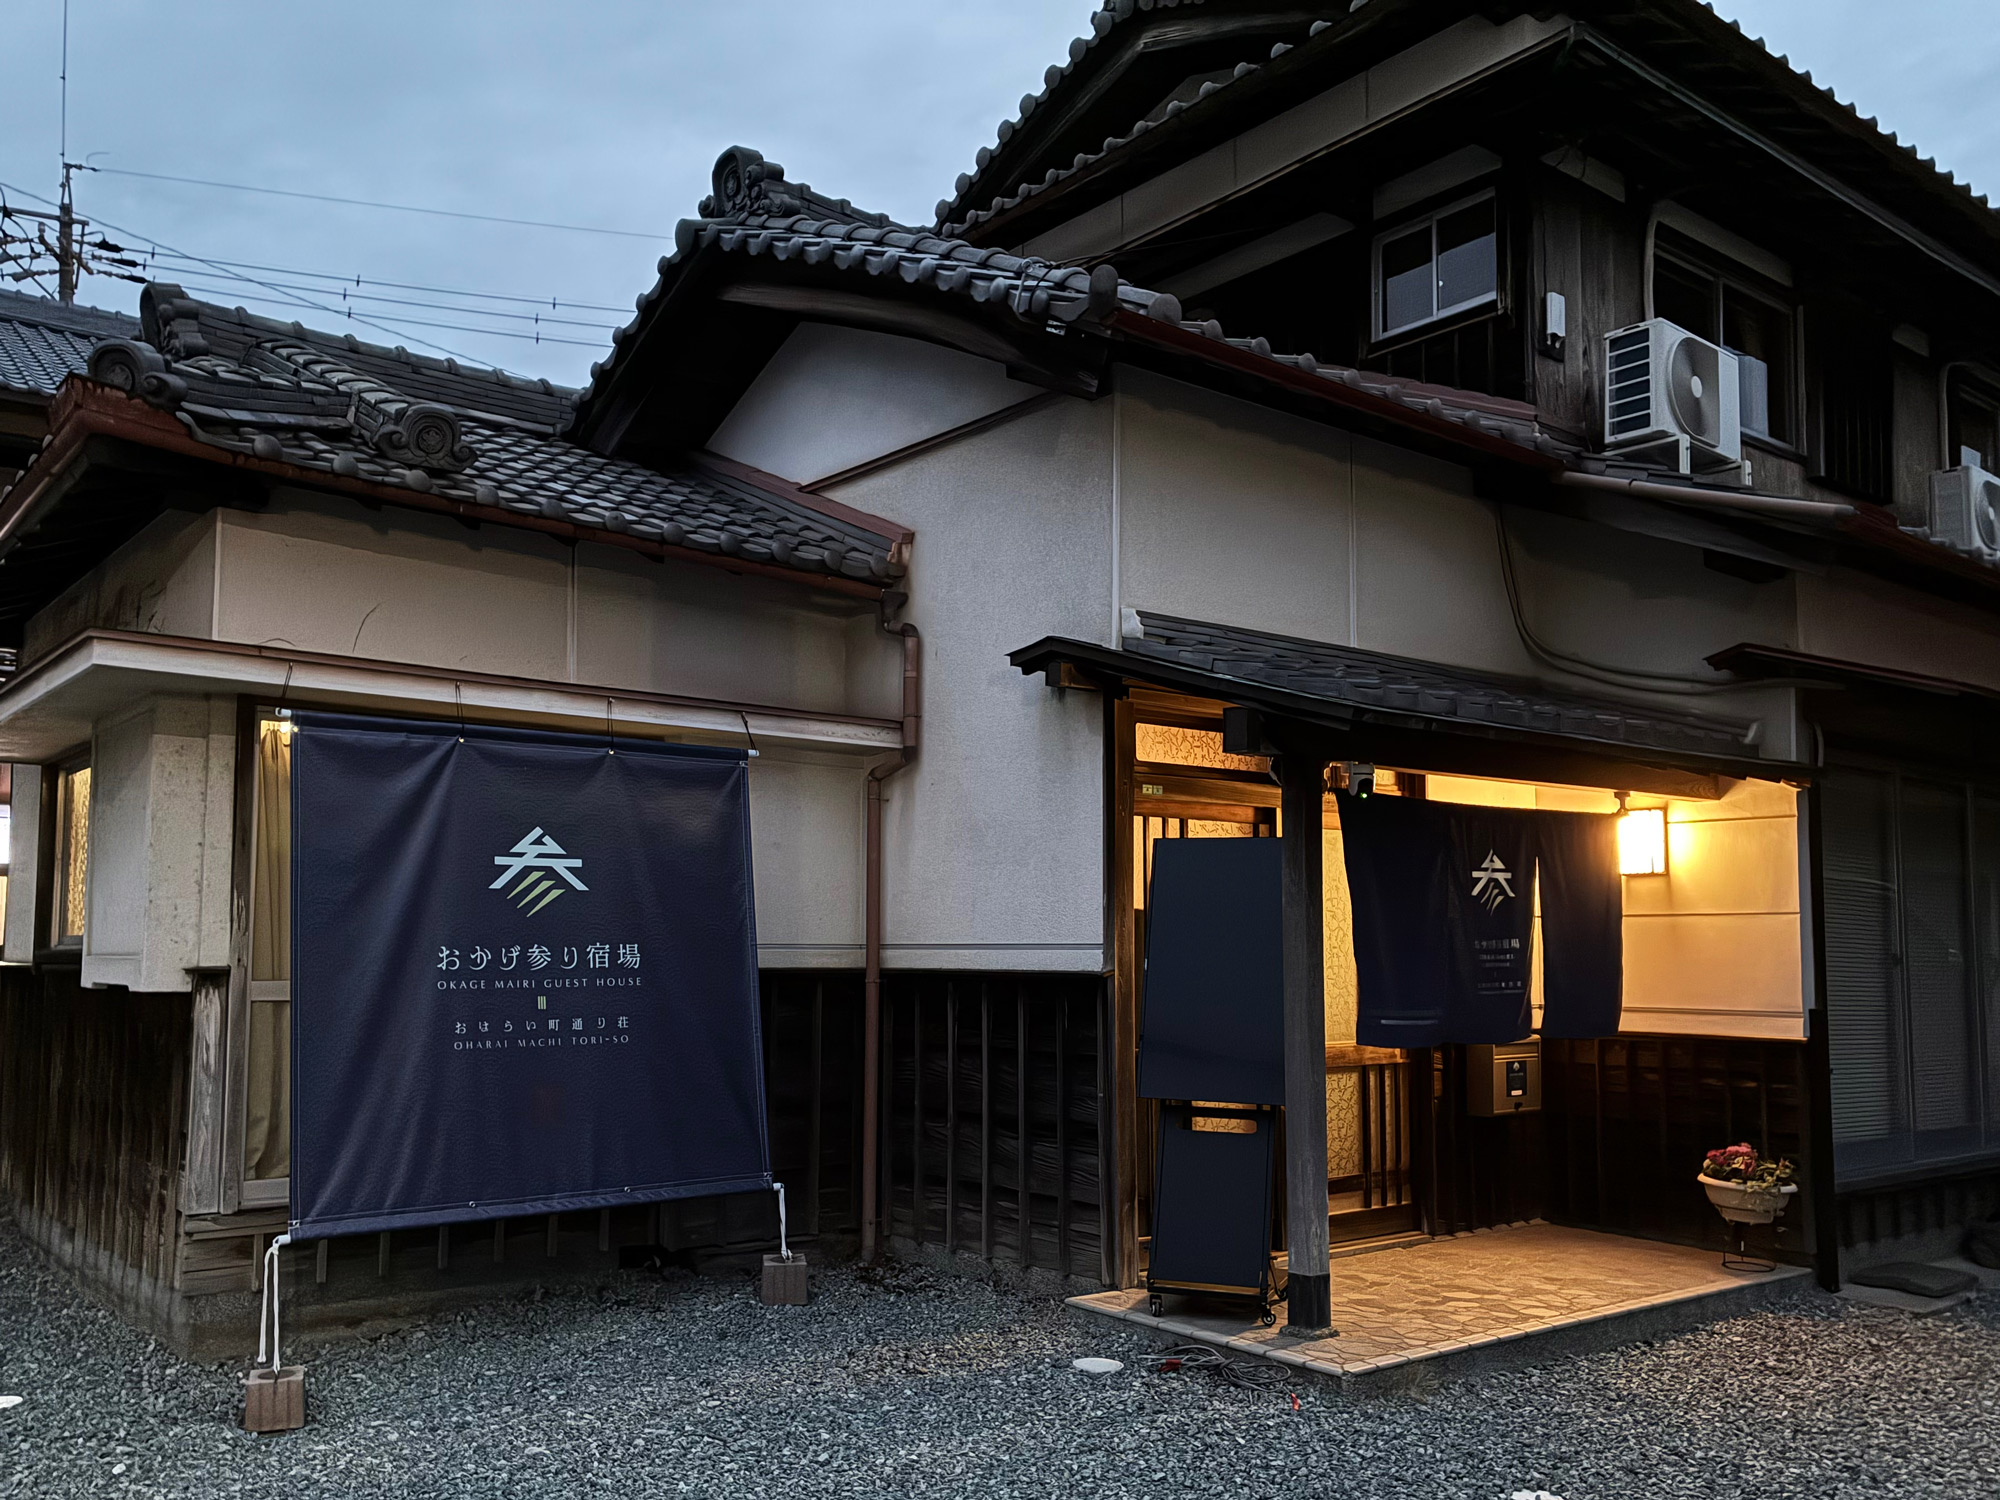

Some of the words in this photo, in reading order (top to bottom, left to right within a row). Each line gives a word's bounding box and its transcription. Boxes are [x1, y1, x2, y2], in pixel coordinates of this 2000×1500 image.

[436, 941, 642, 971] おかげ参り宿場
[437, 979, 487, 990] OKAGE
[494, 979, 536, 989] MAIRI
[543, 978, 589, 988] GUEST
[596, 977, 642, 987] HOUSE
[454, 1016, 629, 1034] おはらい町通り荘
[453, 1040, 508, 1050] OHARAI
[517, 1037, 562, 1048] MACHI
[571, 1034, 629, 1045] TORI-SO
